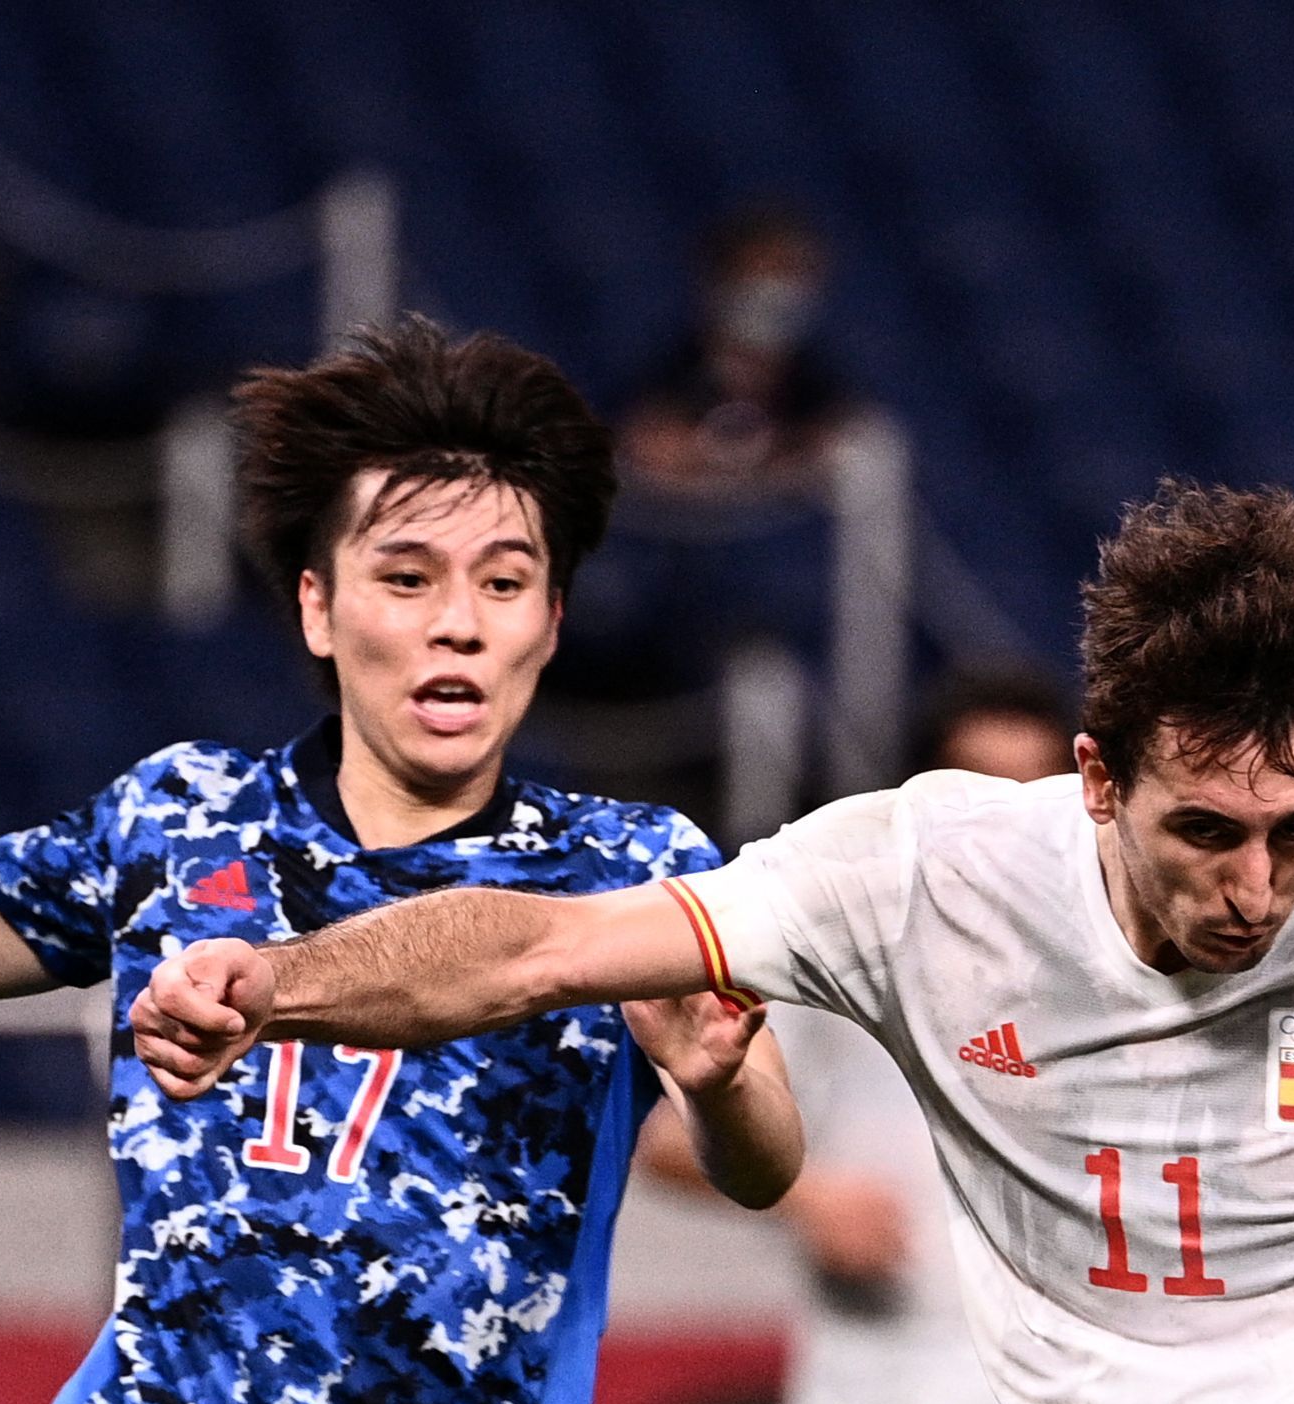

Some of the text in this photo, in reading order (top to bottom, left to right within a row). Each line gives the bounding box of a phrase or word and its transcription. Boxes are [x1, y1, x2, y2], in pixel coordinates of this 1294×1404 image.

[242, 1038, 403, 1184] 17
[958, 1046, 1036, 1078] adidas
[1085, 1148, 1225, 1296] 11
